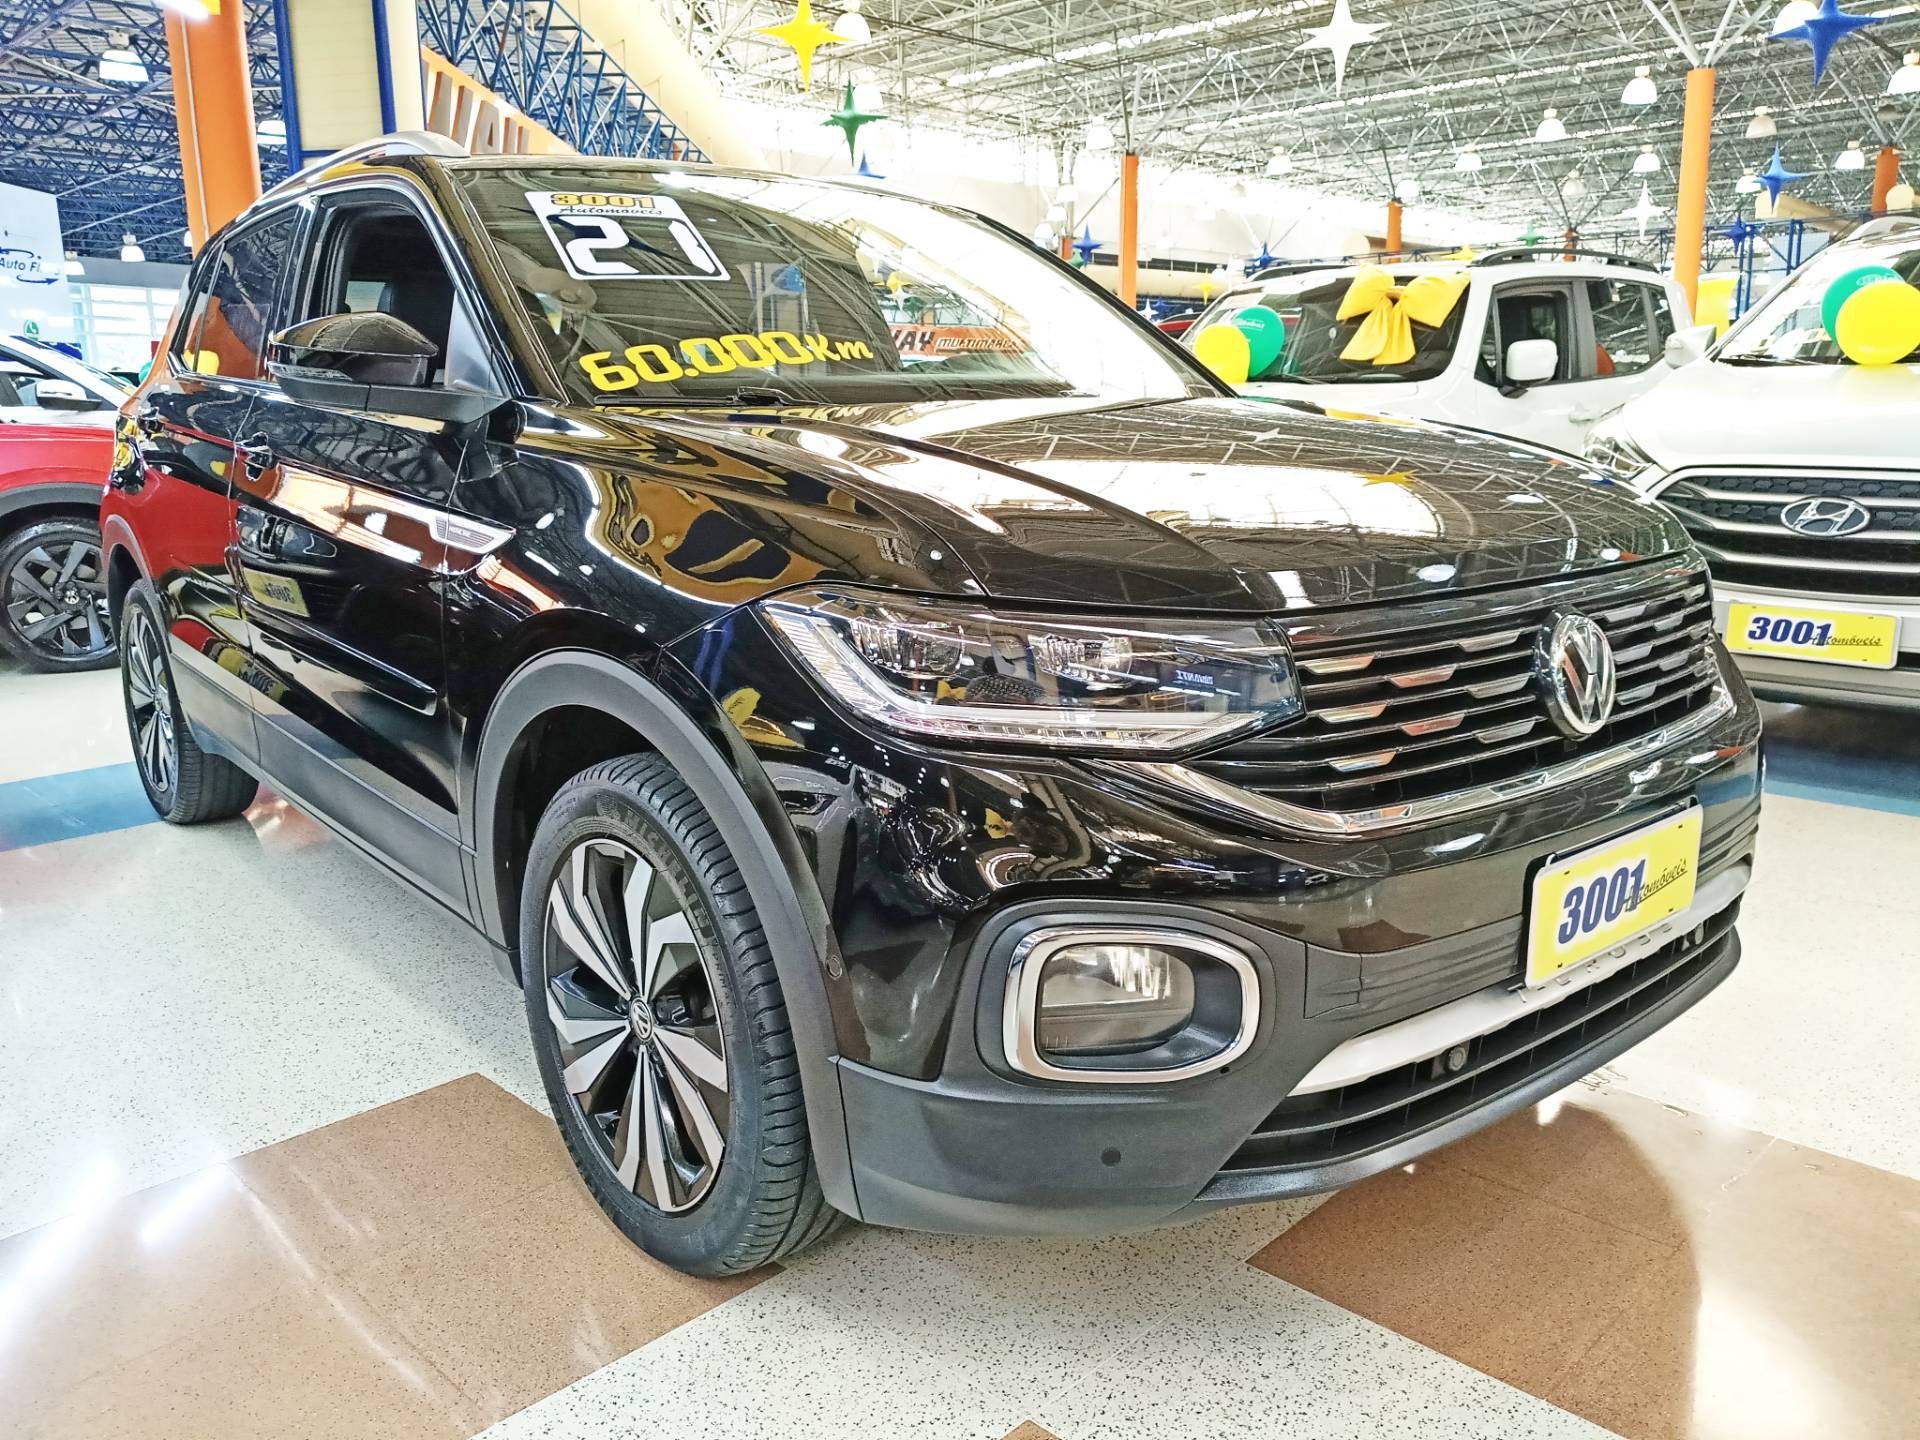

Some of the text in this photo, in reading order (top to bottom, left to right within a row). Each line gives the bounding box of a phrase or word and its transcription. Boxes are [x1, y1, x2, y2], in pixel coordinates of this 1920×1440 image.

[551, 193, 656, 209] 3001
[562, 214, 718, 276] 21
[1747, 616, 1832, 647] 3001
[1557, 858, 1646, 945] 3001
